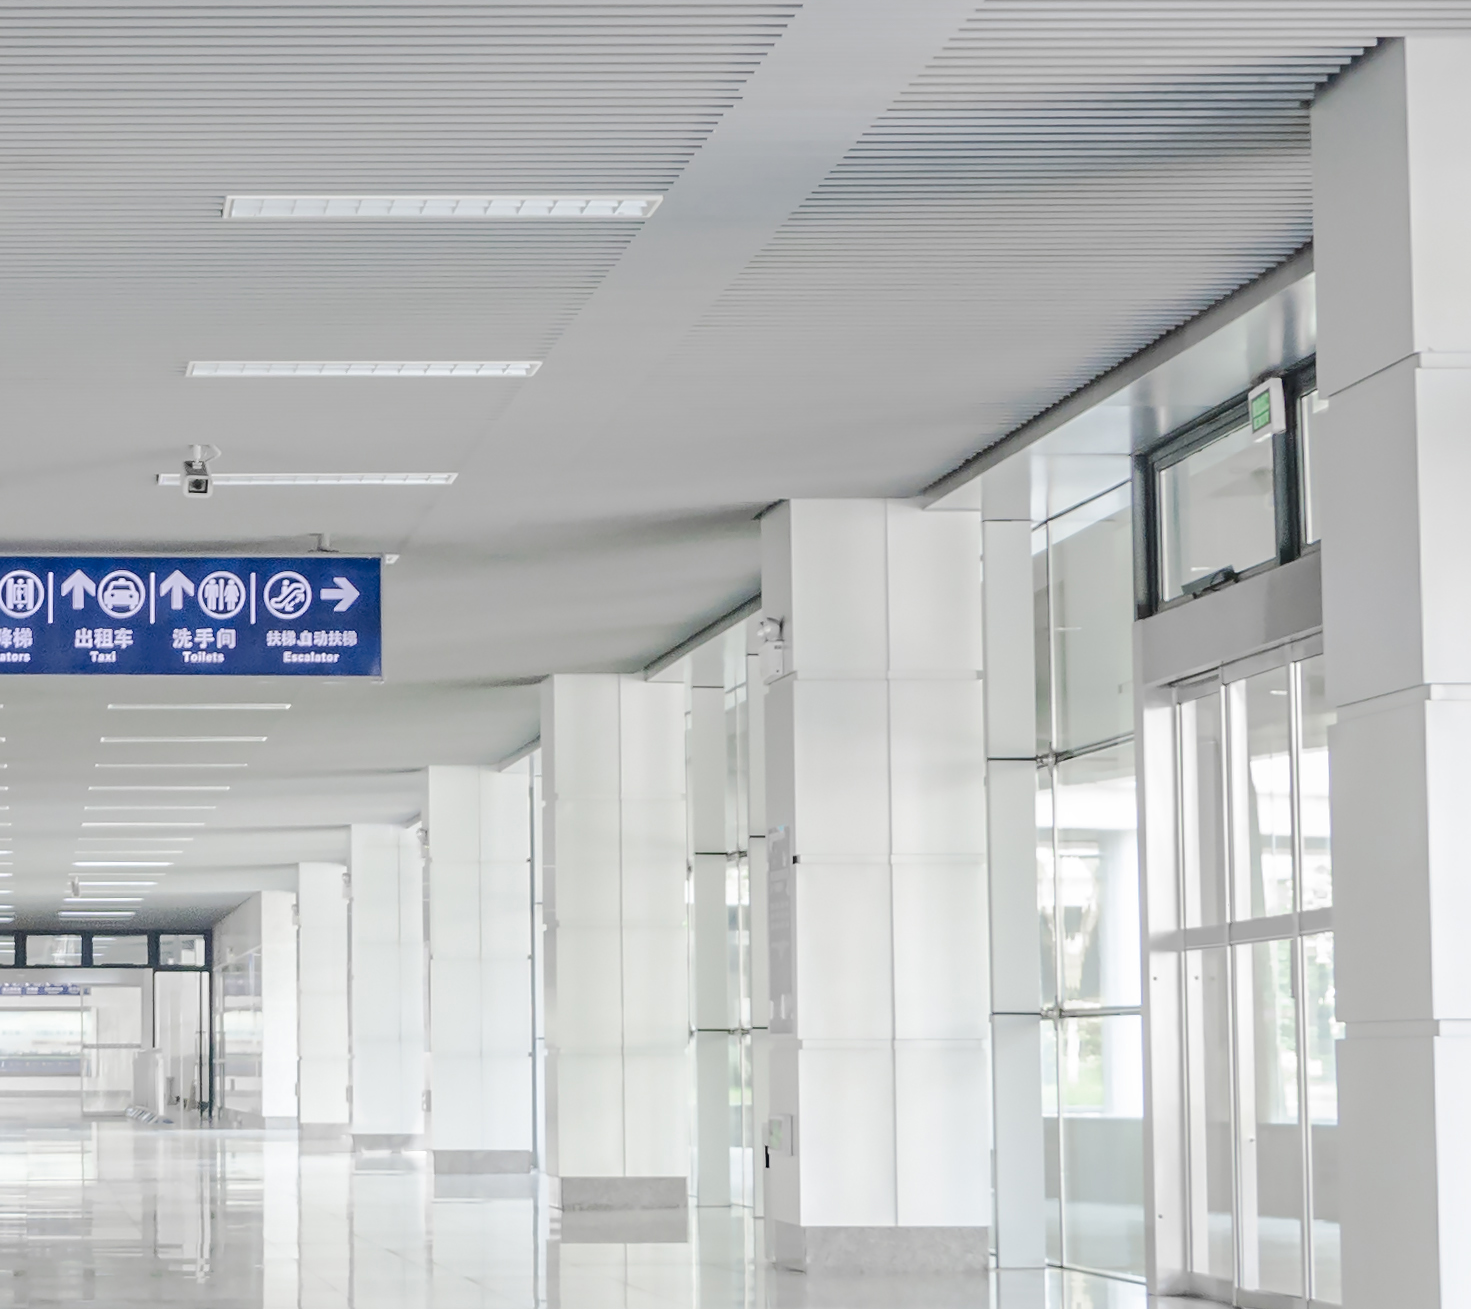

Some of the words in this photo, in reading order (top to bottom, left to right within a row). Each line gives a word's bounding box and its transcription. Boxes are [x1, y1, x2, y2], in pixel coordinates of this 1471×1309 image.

[74, 627, 134, 649] 出租车
[172, 627, 237, 649] 洗手间
[89, 650, 117, 663] Taxi
[182, 650, 225, 663] Toilets
[283, 650, 340, 664] Escalator
